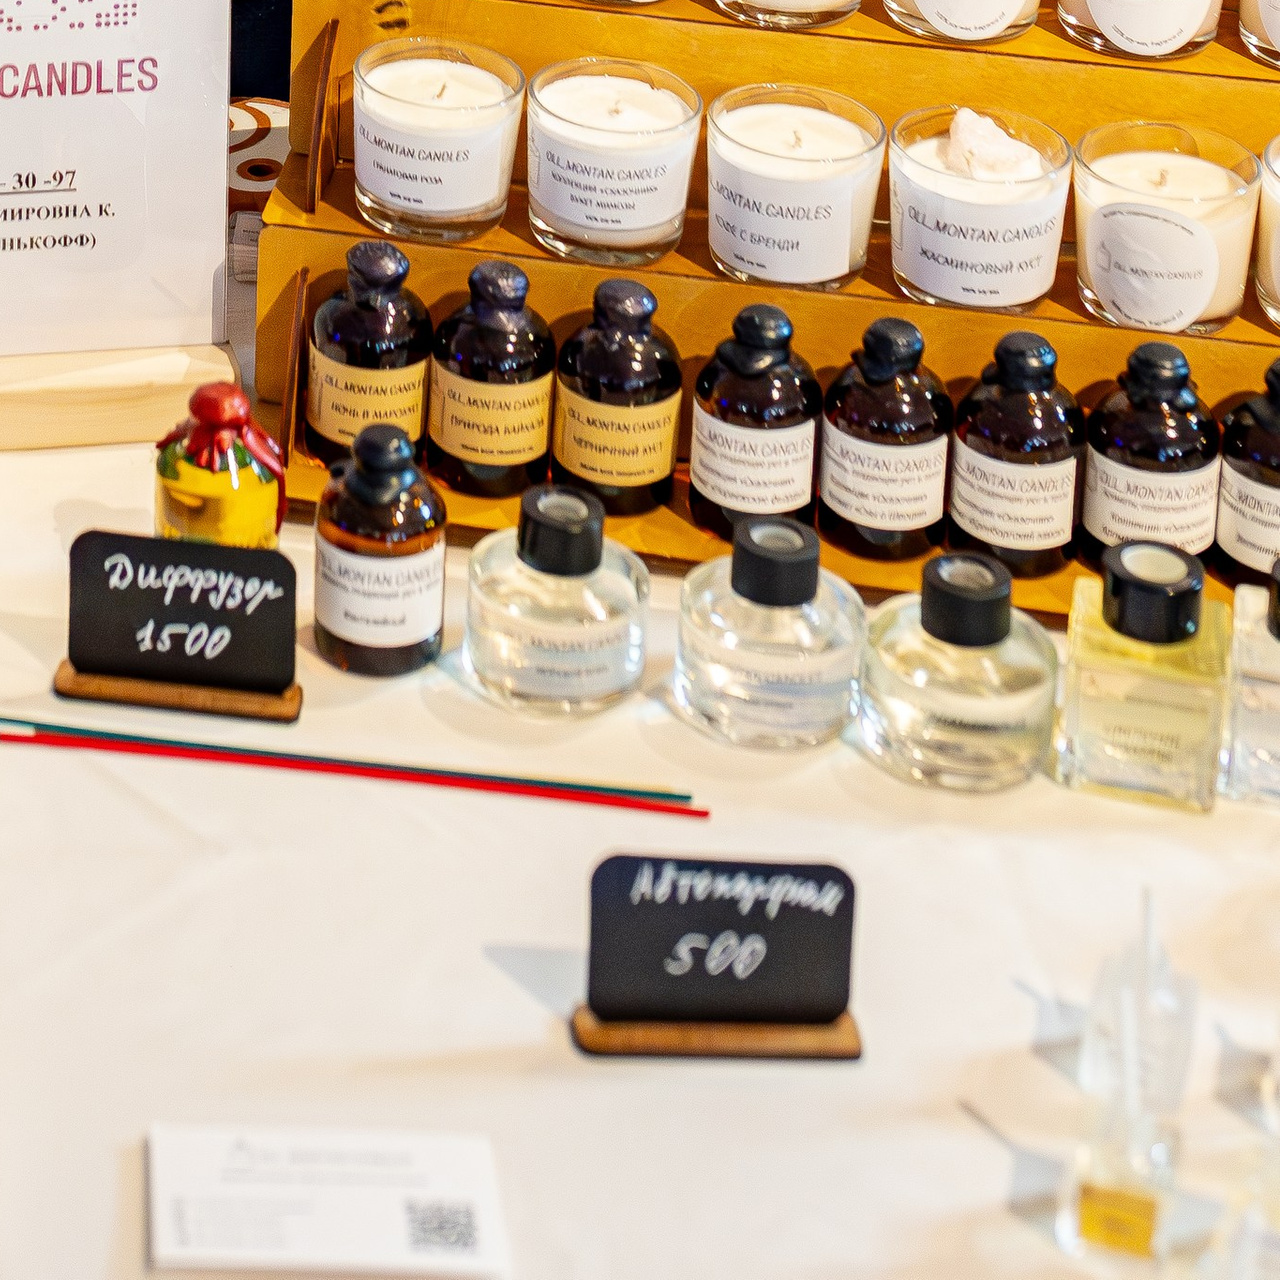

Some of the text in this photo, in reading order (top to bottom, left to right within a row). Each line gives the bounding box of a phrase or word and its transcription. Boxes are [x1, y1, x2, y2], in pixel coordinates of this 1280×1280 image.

[12, 172, 37, 190] 30
[43, 169, 77, 189] -97
[97, 203, 116, 218] К.
[135, 618, 232, 660] 1500
[663, 929, 768, 981] 500
